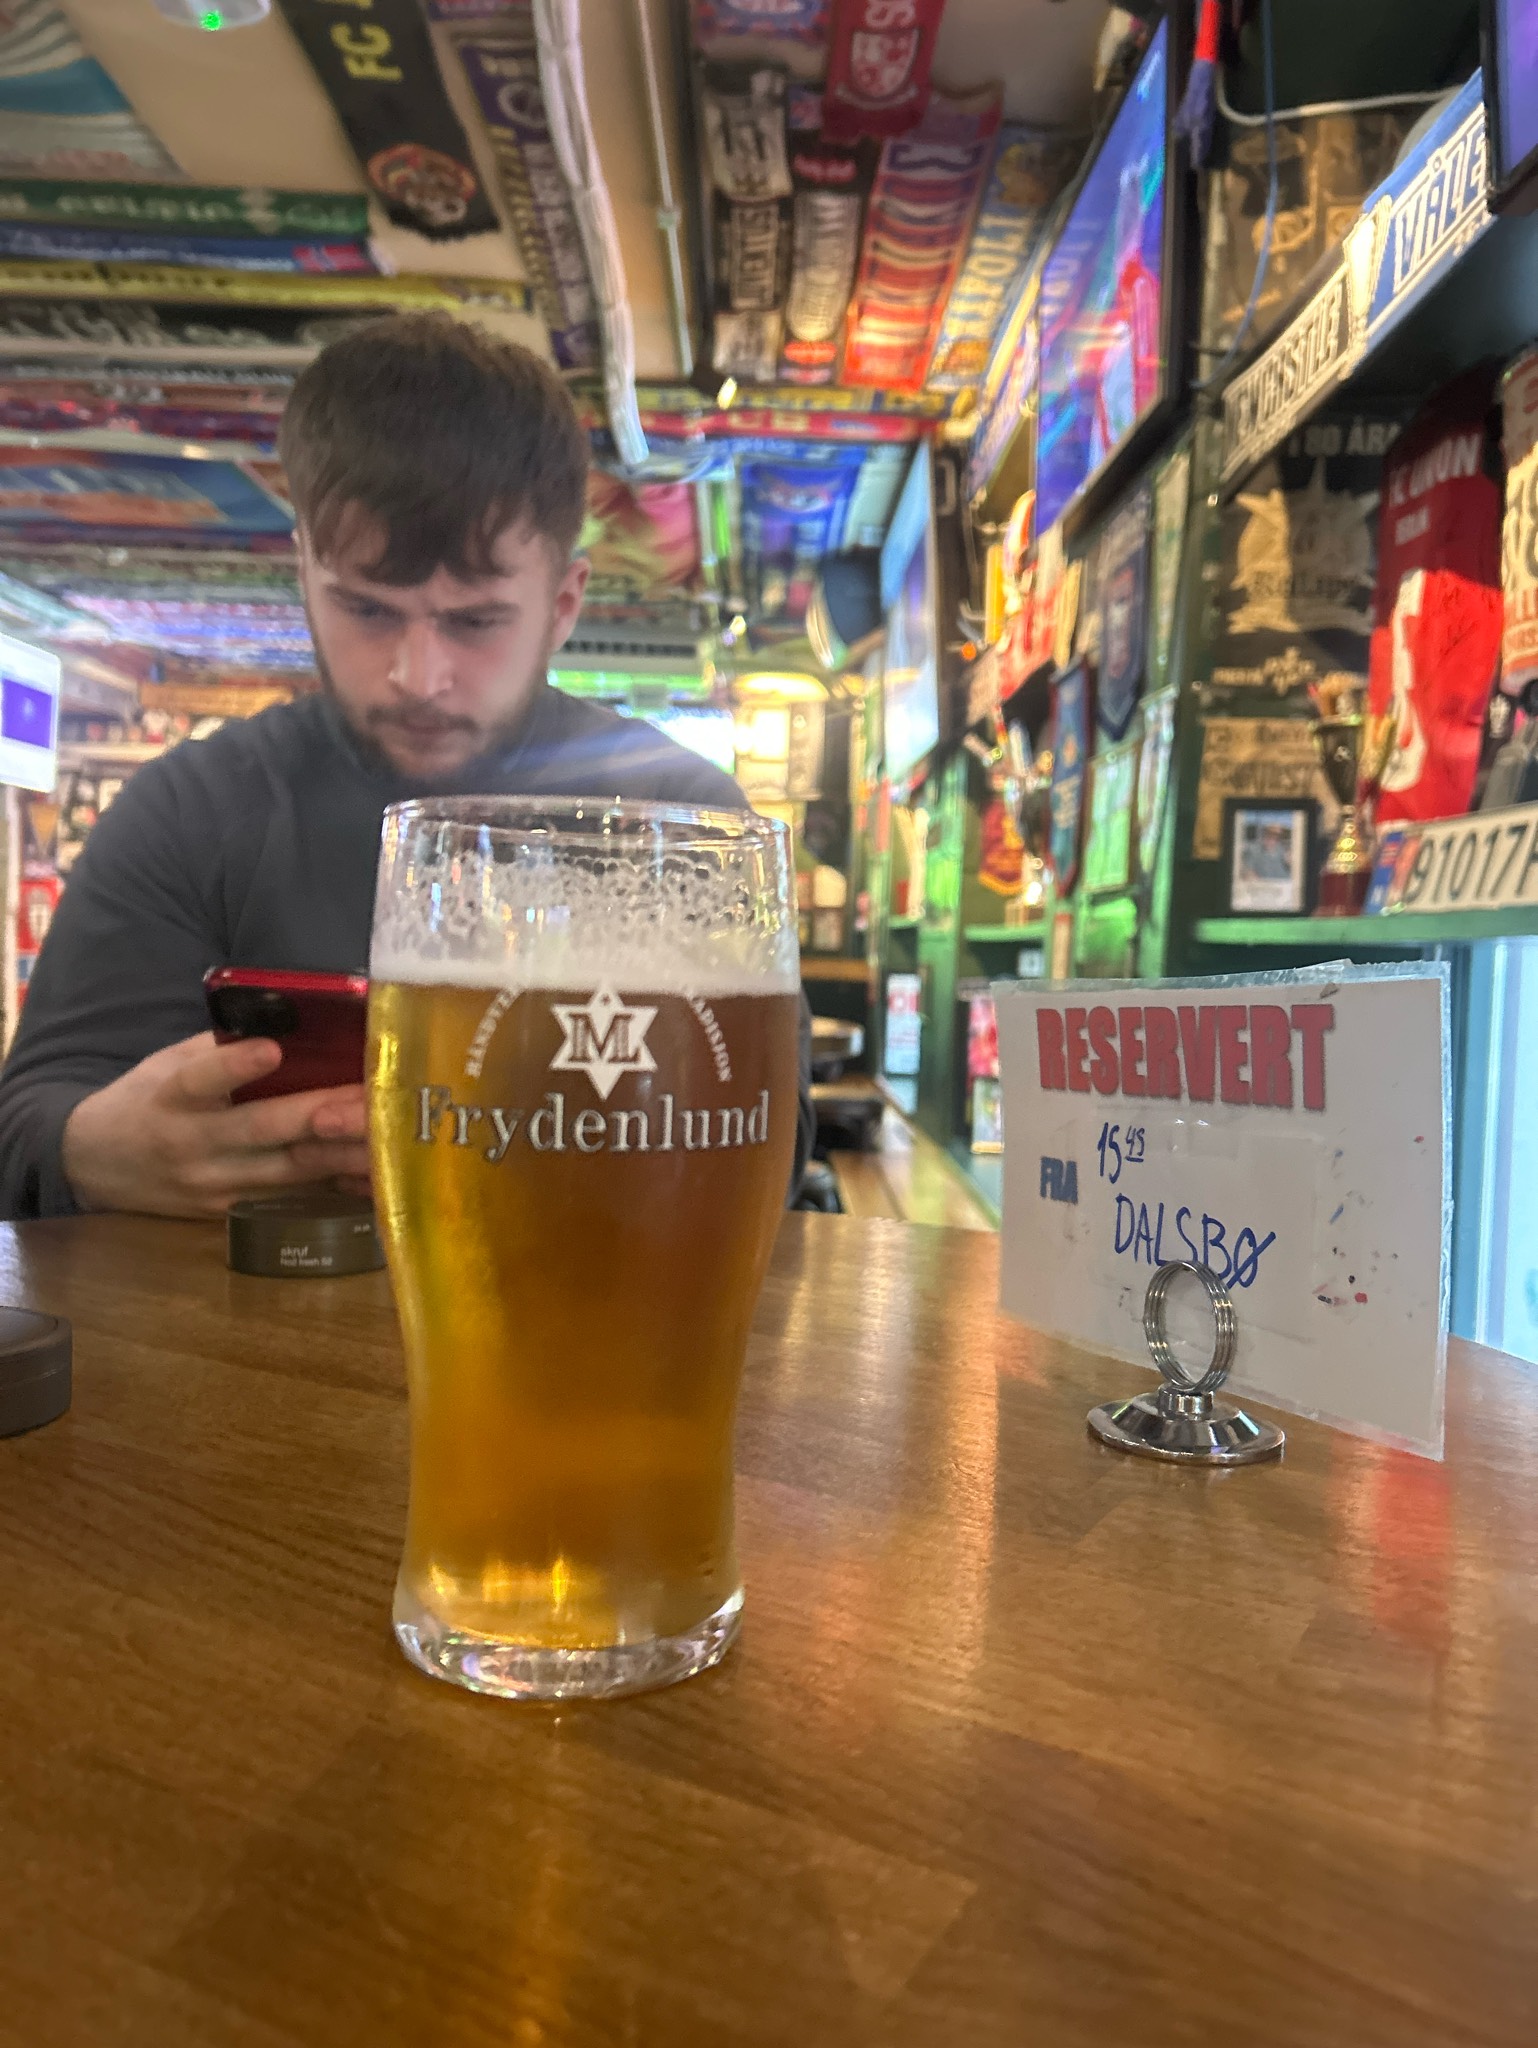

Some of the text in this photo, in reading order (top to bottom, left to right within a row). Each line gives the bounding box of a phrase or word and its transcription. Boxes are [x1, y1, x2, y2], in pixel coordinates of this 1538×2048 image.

[330, 22, 405, 81] FC
[1036, 1003, 1336, 1112] RESERVERT
[415, 1085, 771, 1163] Frydenlund
[1114, 1193, 1277, 1289] DALSBØ
